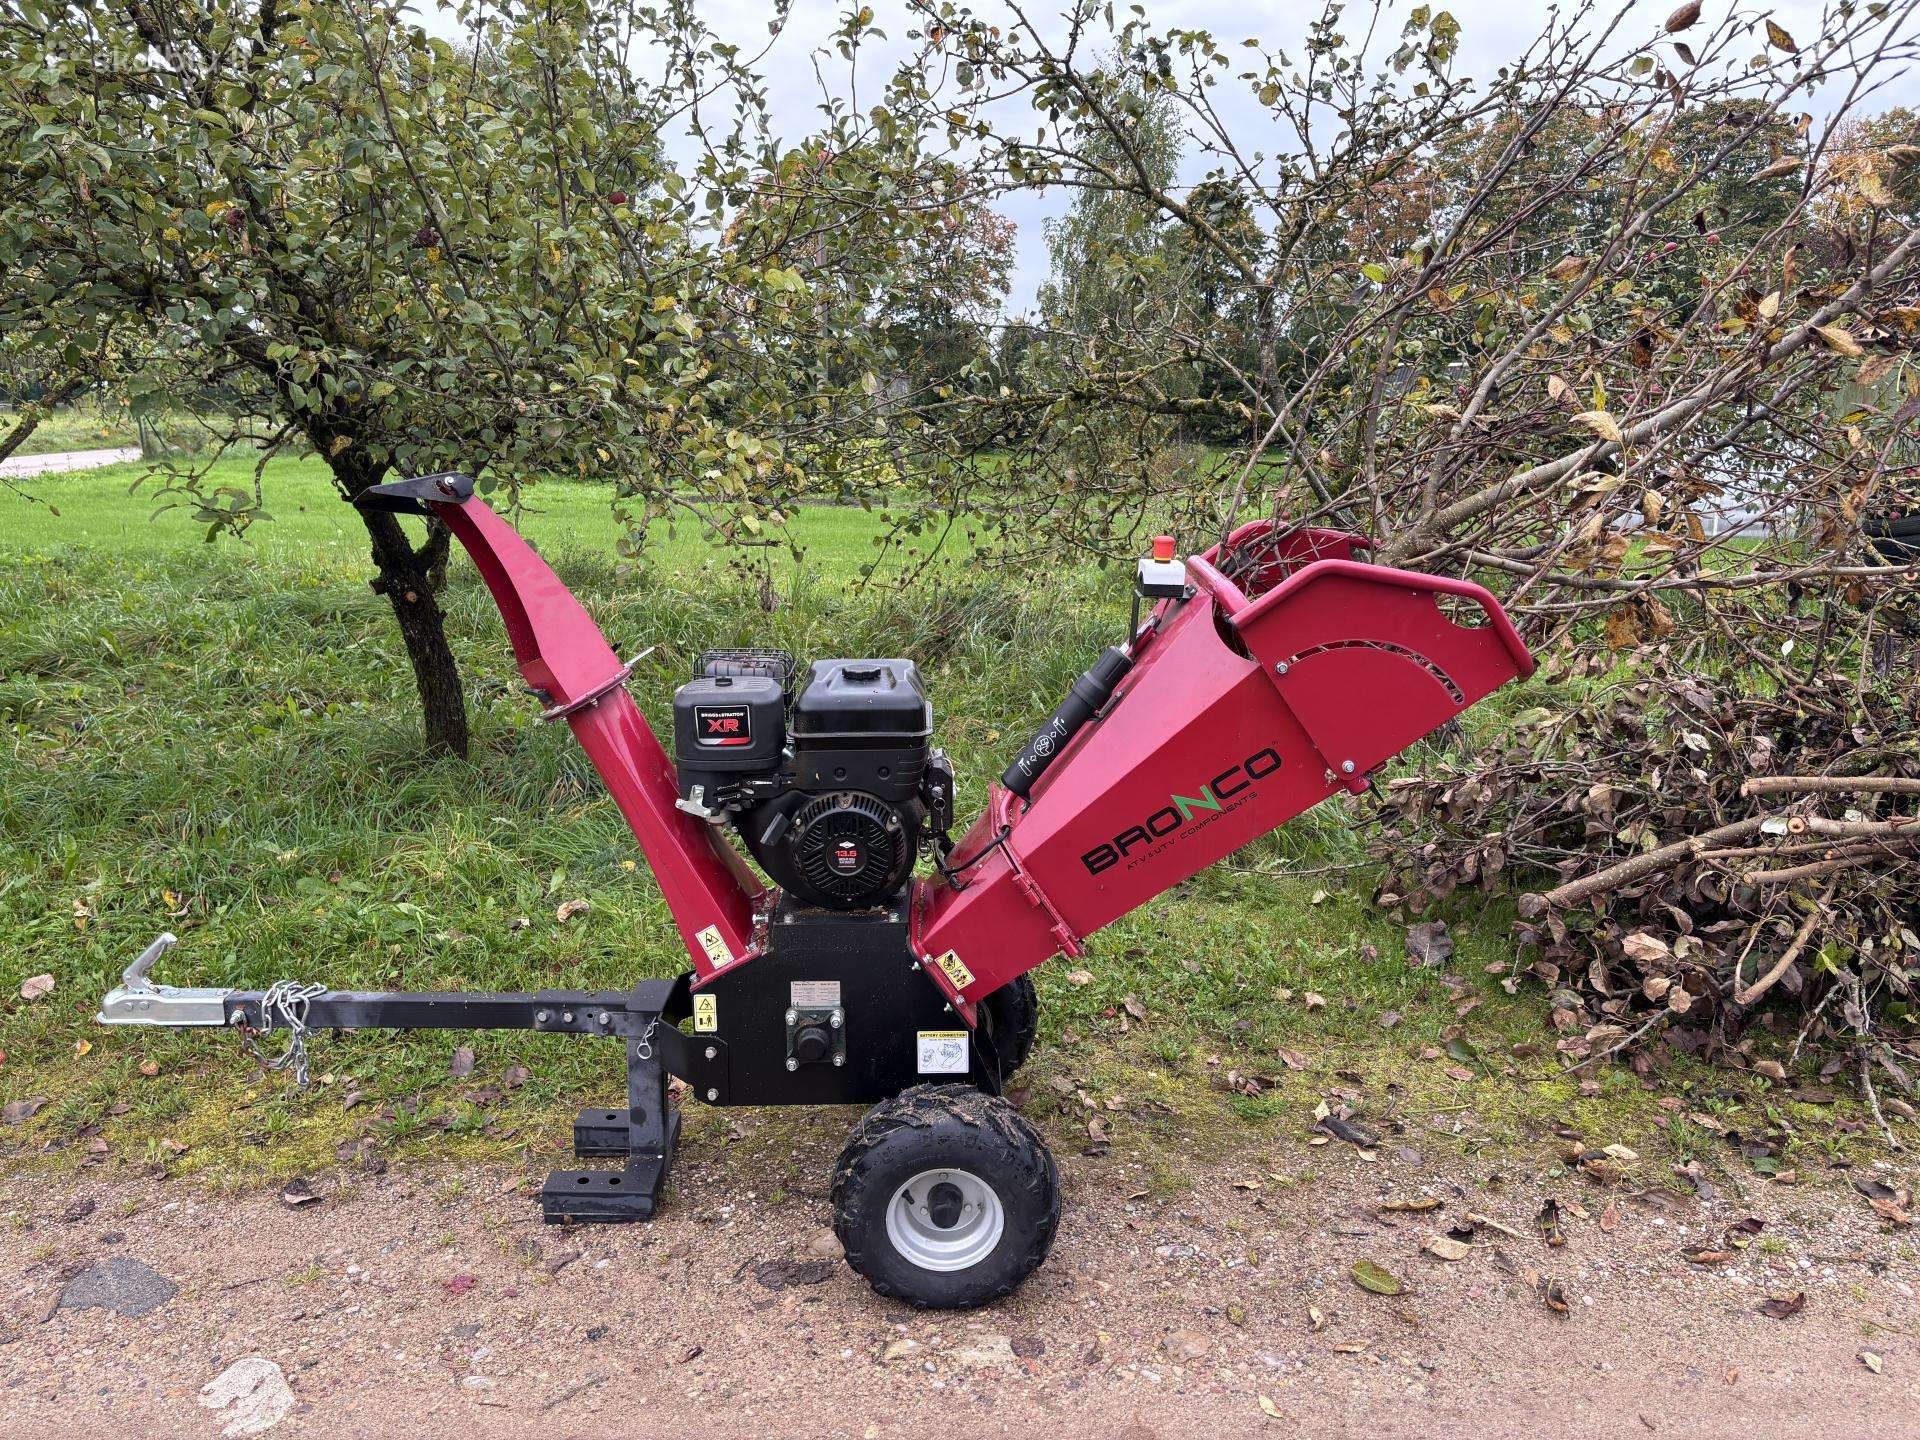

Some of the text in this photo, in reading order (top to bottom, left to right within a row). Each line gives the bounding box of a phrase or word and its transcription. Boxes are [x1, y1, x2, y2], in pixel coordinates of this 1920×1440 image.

[707, 718, 739, 732] XR
[1080, 747, 1282, 876] BRONCO
[1179, 791, 1258, 840] COMPONENTS
